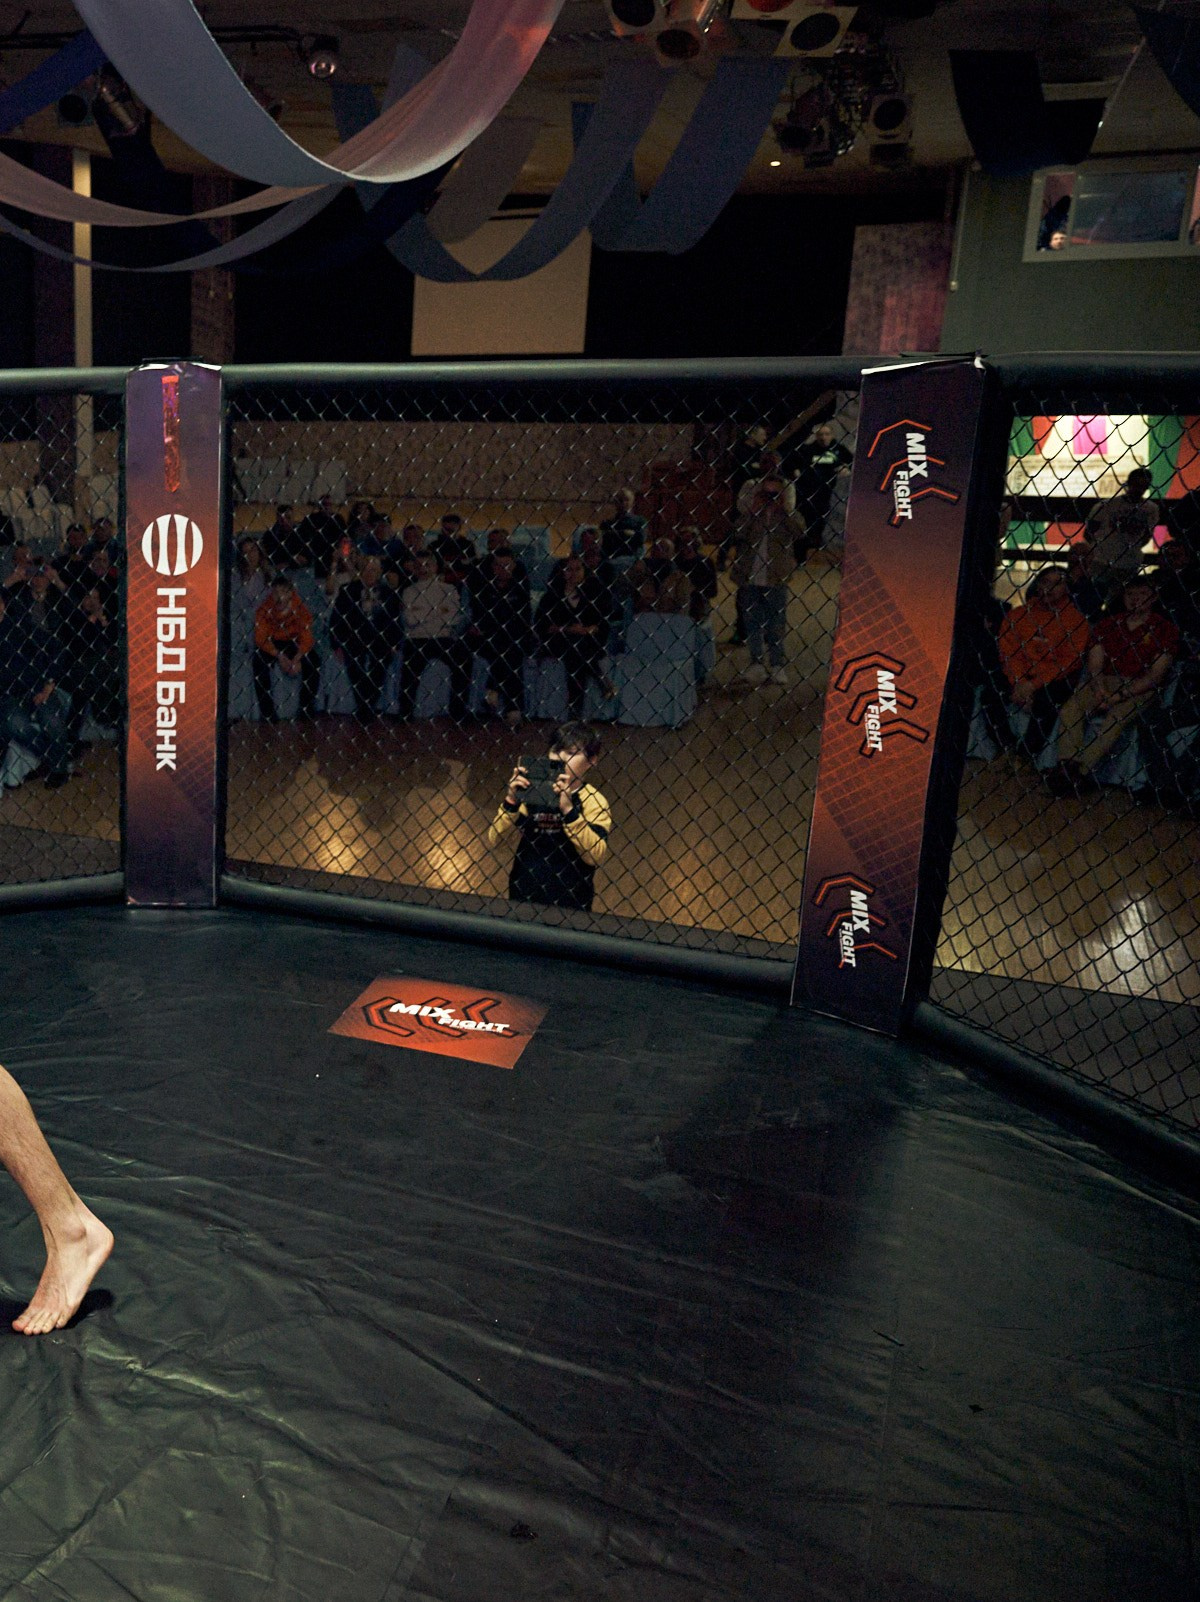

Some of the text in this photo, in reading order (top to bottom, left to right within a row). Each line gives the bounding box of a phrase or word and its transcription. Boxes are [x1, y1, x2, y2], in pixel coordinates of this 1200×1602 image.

[905, 432, 929, 478] MIX
[896, 470, 913, 520] FIGHT
[155, 587, 187, 771] НБД Банк
[876, 670, 898, 715] MIX
[867, 704, 883, 752] FIGHT
[850, 889, 871, 934] MIX
[841, 921, 857, 968] FIGHT
[389, 1002, 456, 1019] MIX
[437, 1016, 511, 1033] FIGHT
